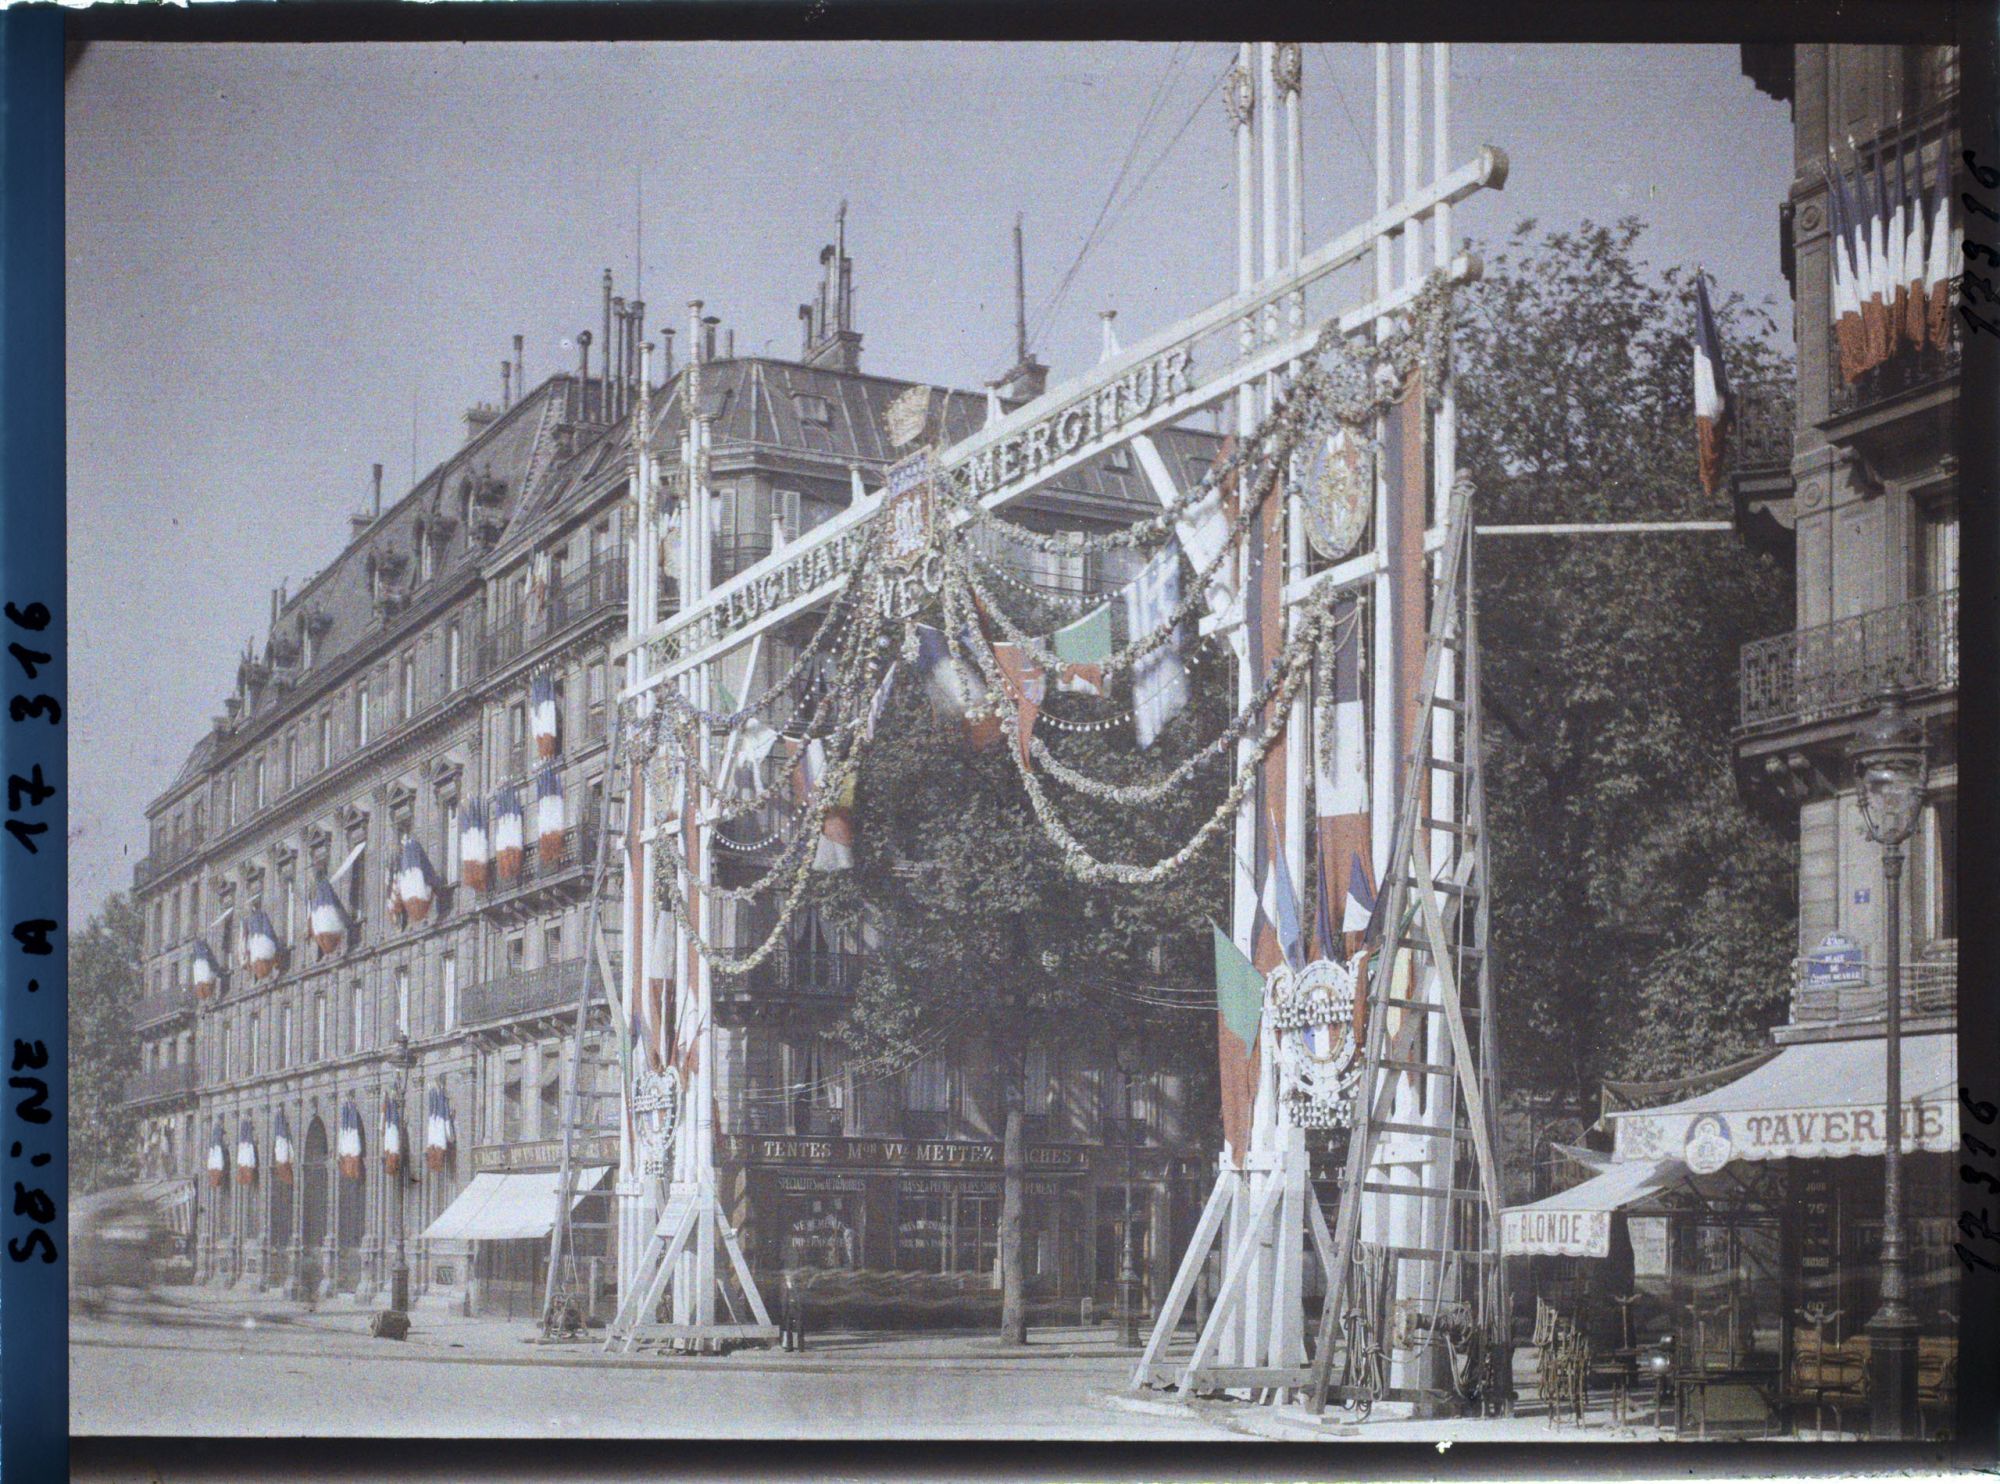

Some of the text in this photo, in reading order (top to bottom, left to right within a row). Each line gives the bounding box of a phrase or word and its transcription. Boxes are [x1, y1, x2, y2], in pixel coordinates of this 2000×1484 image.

[876, 548, 944, 618] NEC
[967, 346, 1192, 499] MERGITUR
[11, 918, 59, 956] A
[763, 1140, 832, 1159] TENTES
[916, 1143, 994, 1162] METTEZ
[1520, 1213, 1583, 1244] BLONDE
